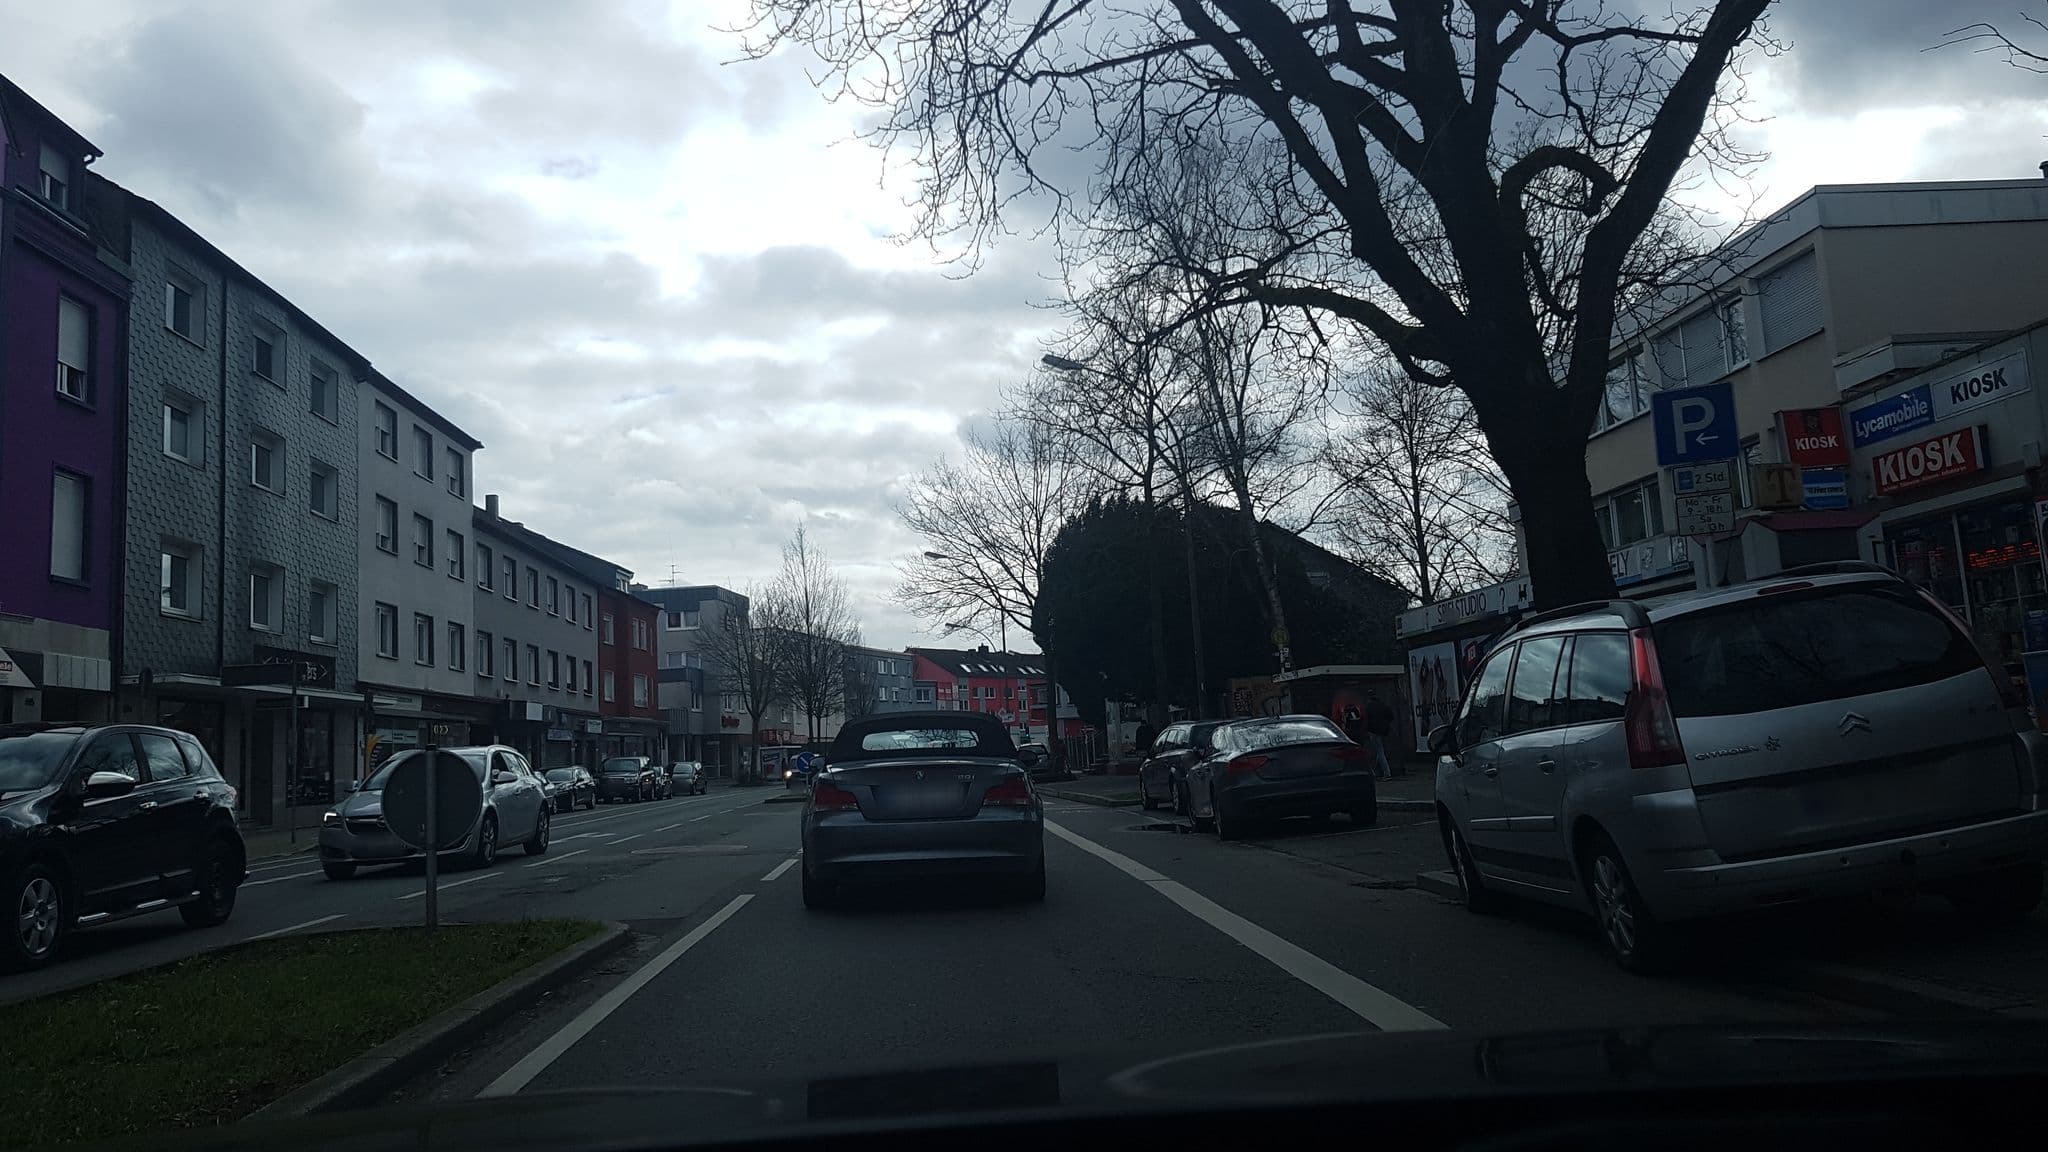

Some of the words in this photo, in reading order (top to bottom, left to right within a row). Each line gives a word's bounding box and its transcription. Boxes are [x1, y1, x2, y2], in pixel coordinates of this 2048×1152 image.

[1950, 367, 2008, 404] KIOSK
[1671, 396, 1715, 455] P
[1855, 398, 1929, 439] Lycamobile
[1794, 435, 1839, 451] KIOSK
[1878, 433, 1966, 486] KIOSK
[1695, 474, 1702, 484] 2
[1437, 592, 1487, 623] SPSTUDIO
